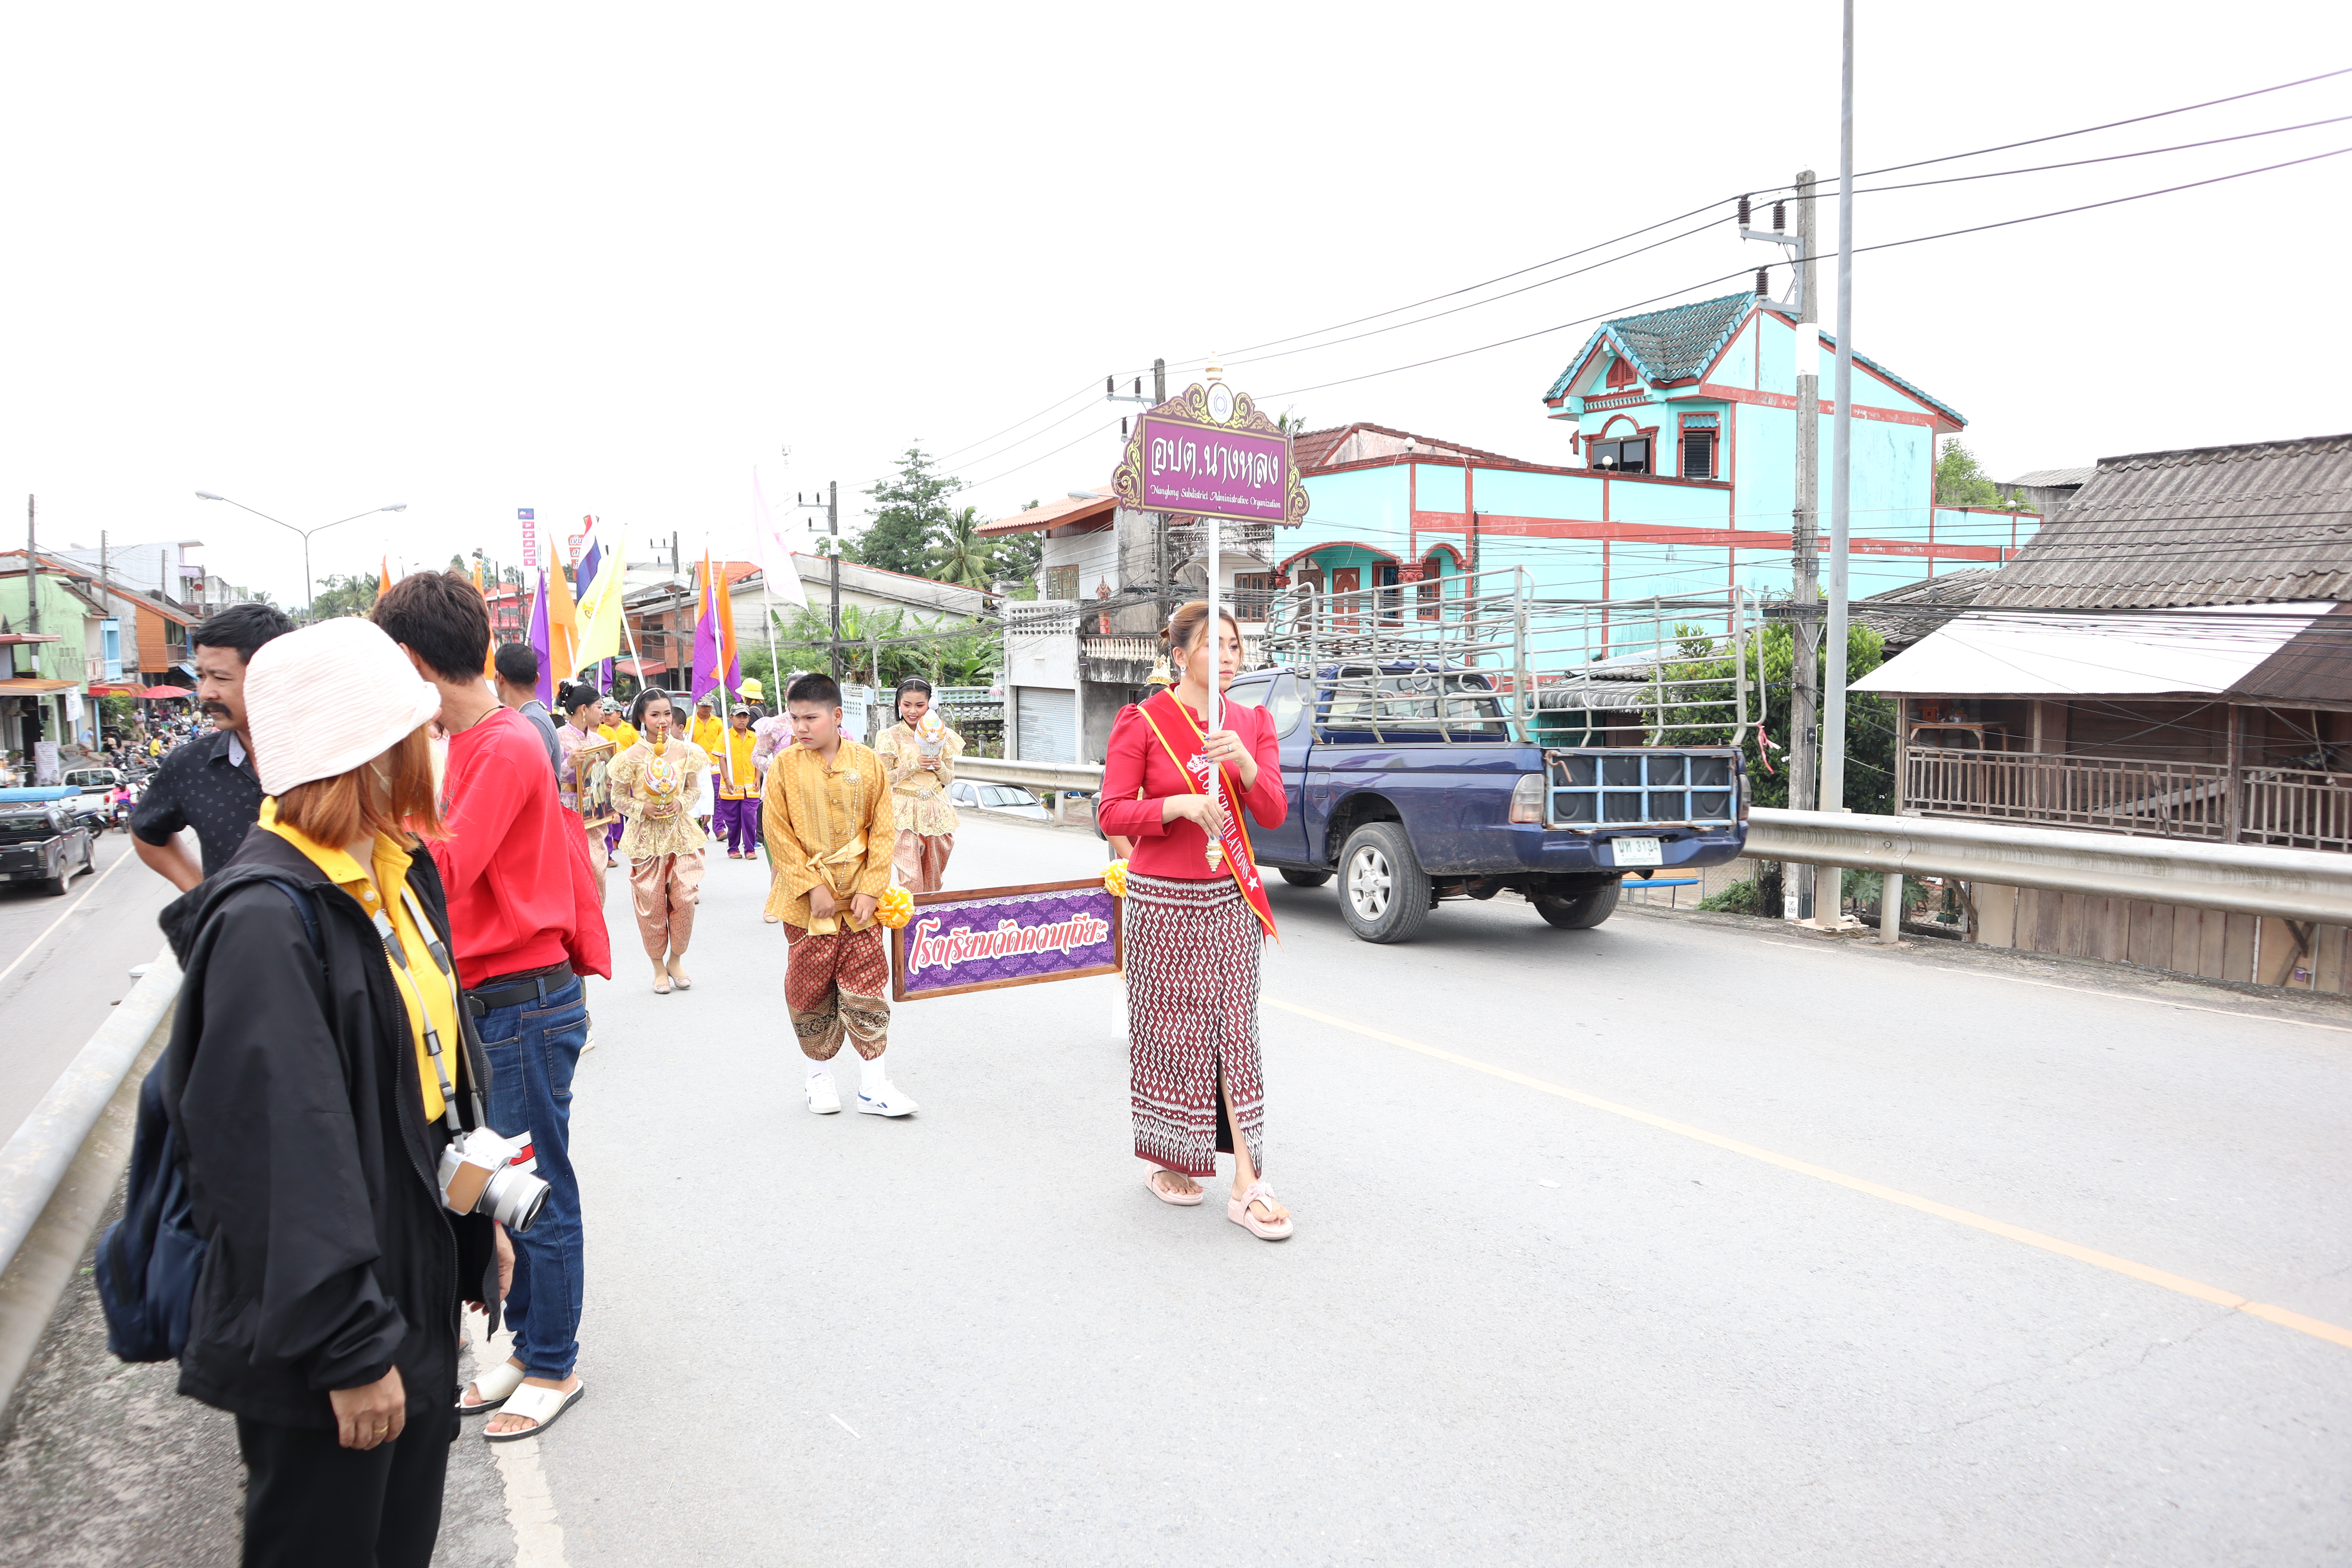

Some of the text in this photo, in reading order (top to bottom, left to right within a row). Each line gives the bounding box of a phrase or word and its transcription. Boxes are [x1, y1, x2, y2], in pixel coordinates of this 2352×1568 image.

[1151, 436, 1279, 489] อบต.นางหลง
[1150, 484, 1281, 510] Nanglong Subdistrict Administrative Organization
